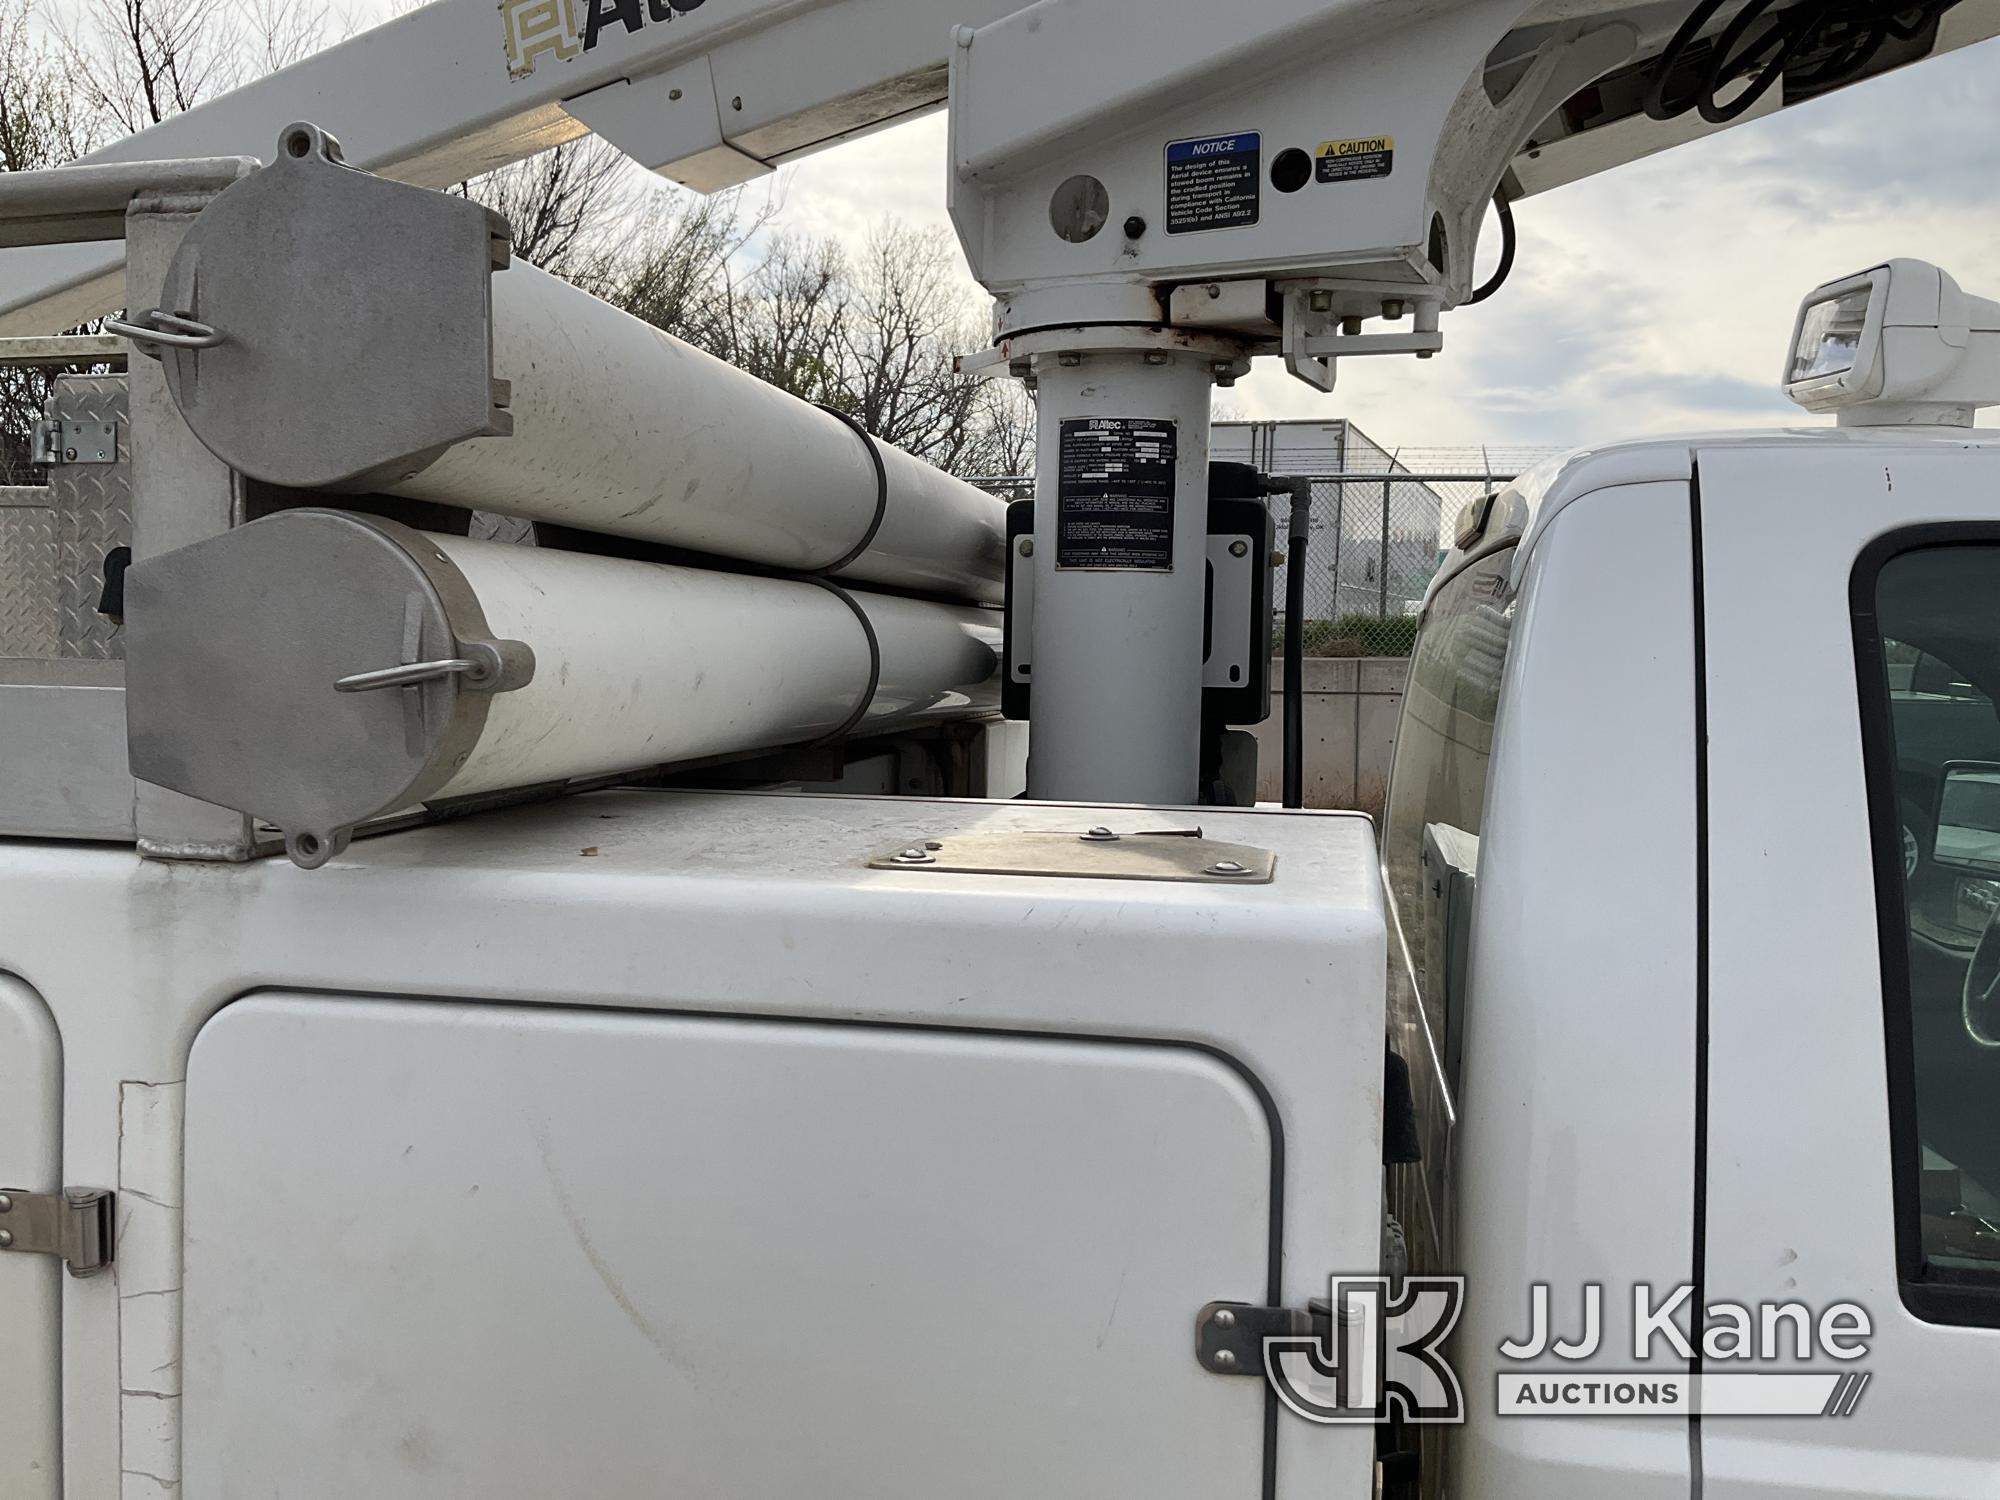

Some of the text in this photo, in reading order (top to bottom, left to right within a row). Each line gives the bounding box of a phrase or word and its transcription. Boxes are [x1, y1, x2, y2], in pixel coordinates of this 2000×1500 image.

[1192, 140, 1236, 155] NOTICE
[1339, 140, 1385, 154] CAUTION
[1209, 182, 1235, 191] position
[1193, 191, 1222, 200] transport
[1171, 201, 1206, 210] compliance
[1225, 194, 1256, 202] California
[1098, 420, 1121, 430] Altec
